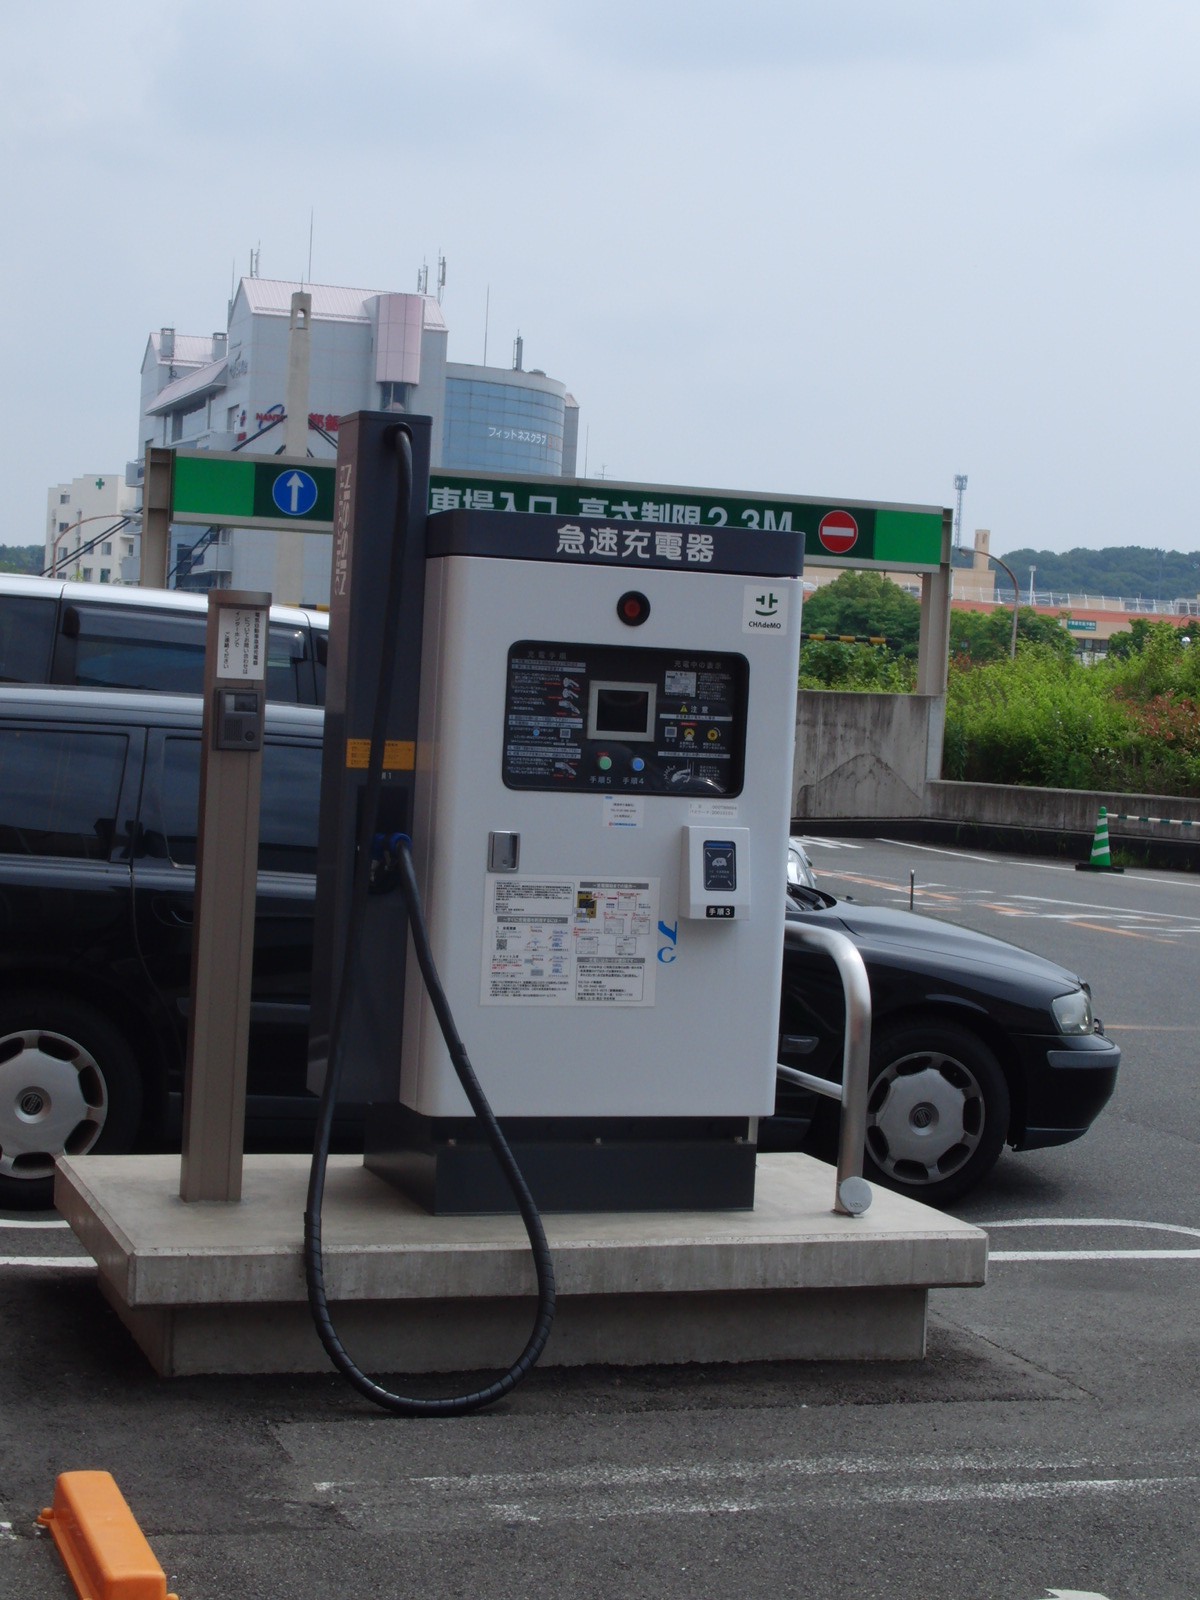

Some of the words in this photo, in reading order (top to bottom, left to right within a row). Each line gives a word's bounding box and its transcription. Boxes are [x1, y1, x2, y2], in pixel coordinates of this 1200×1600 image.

[488, 426, 547, 445] フィットネスクラブ
[578, 497, 793, 532] 高さ制限23M
[557, 524, 714, 563] 急速充電器
[748, 621, 782, 629] CHAdeMO
[690, 705, 709, 714] 注意
[589, 775, 612, 784] 手順5
[622, 776, 645, 785] 手順4
[708, 907, 731, 916] 手順3
